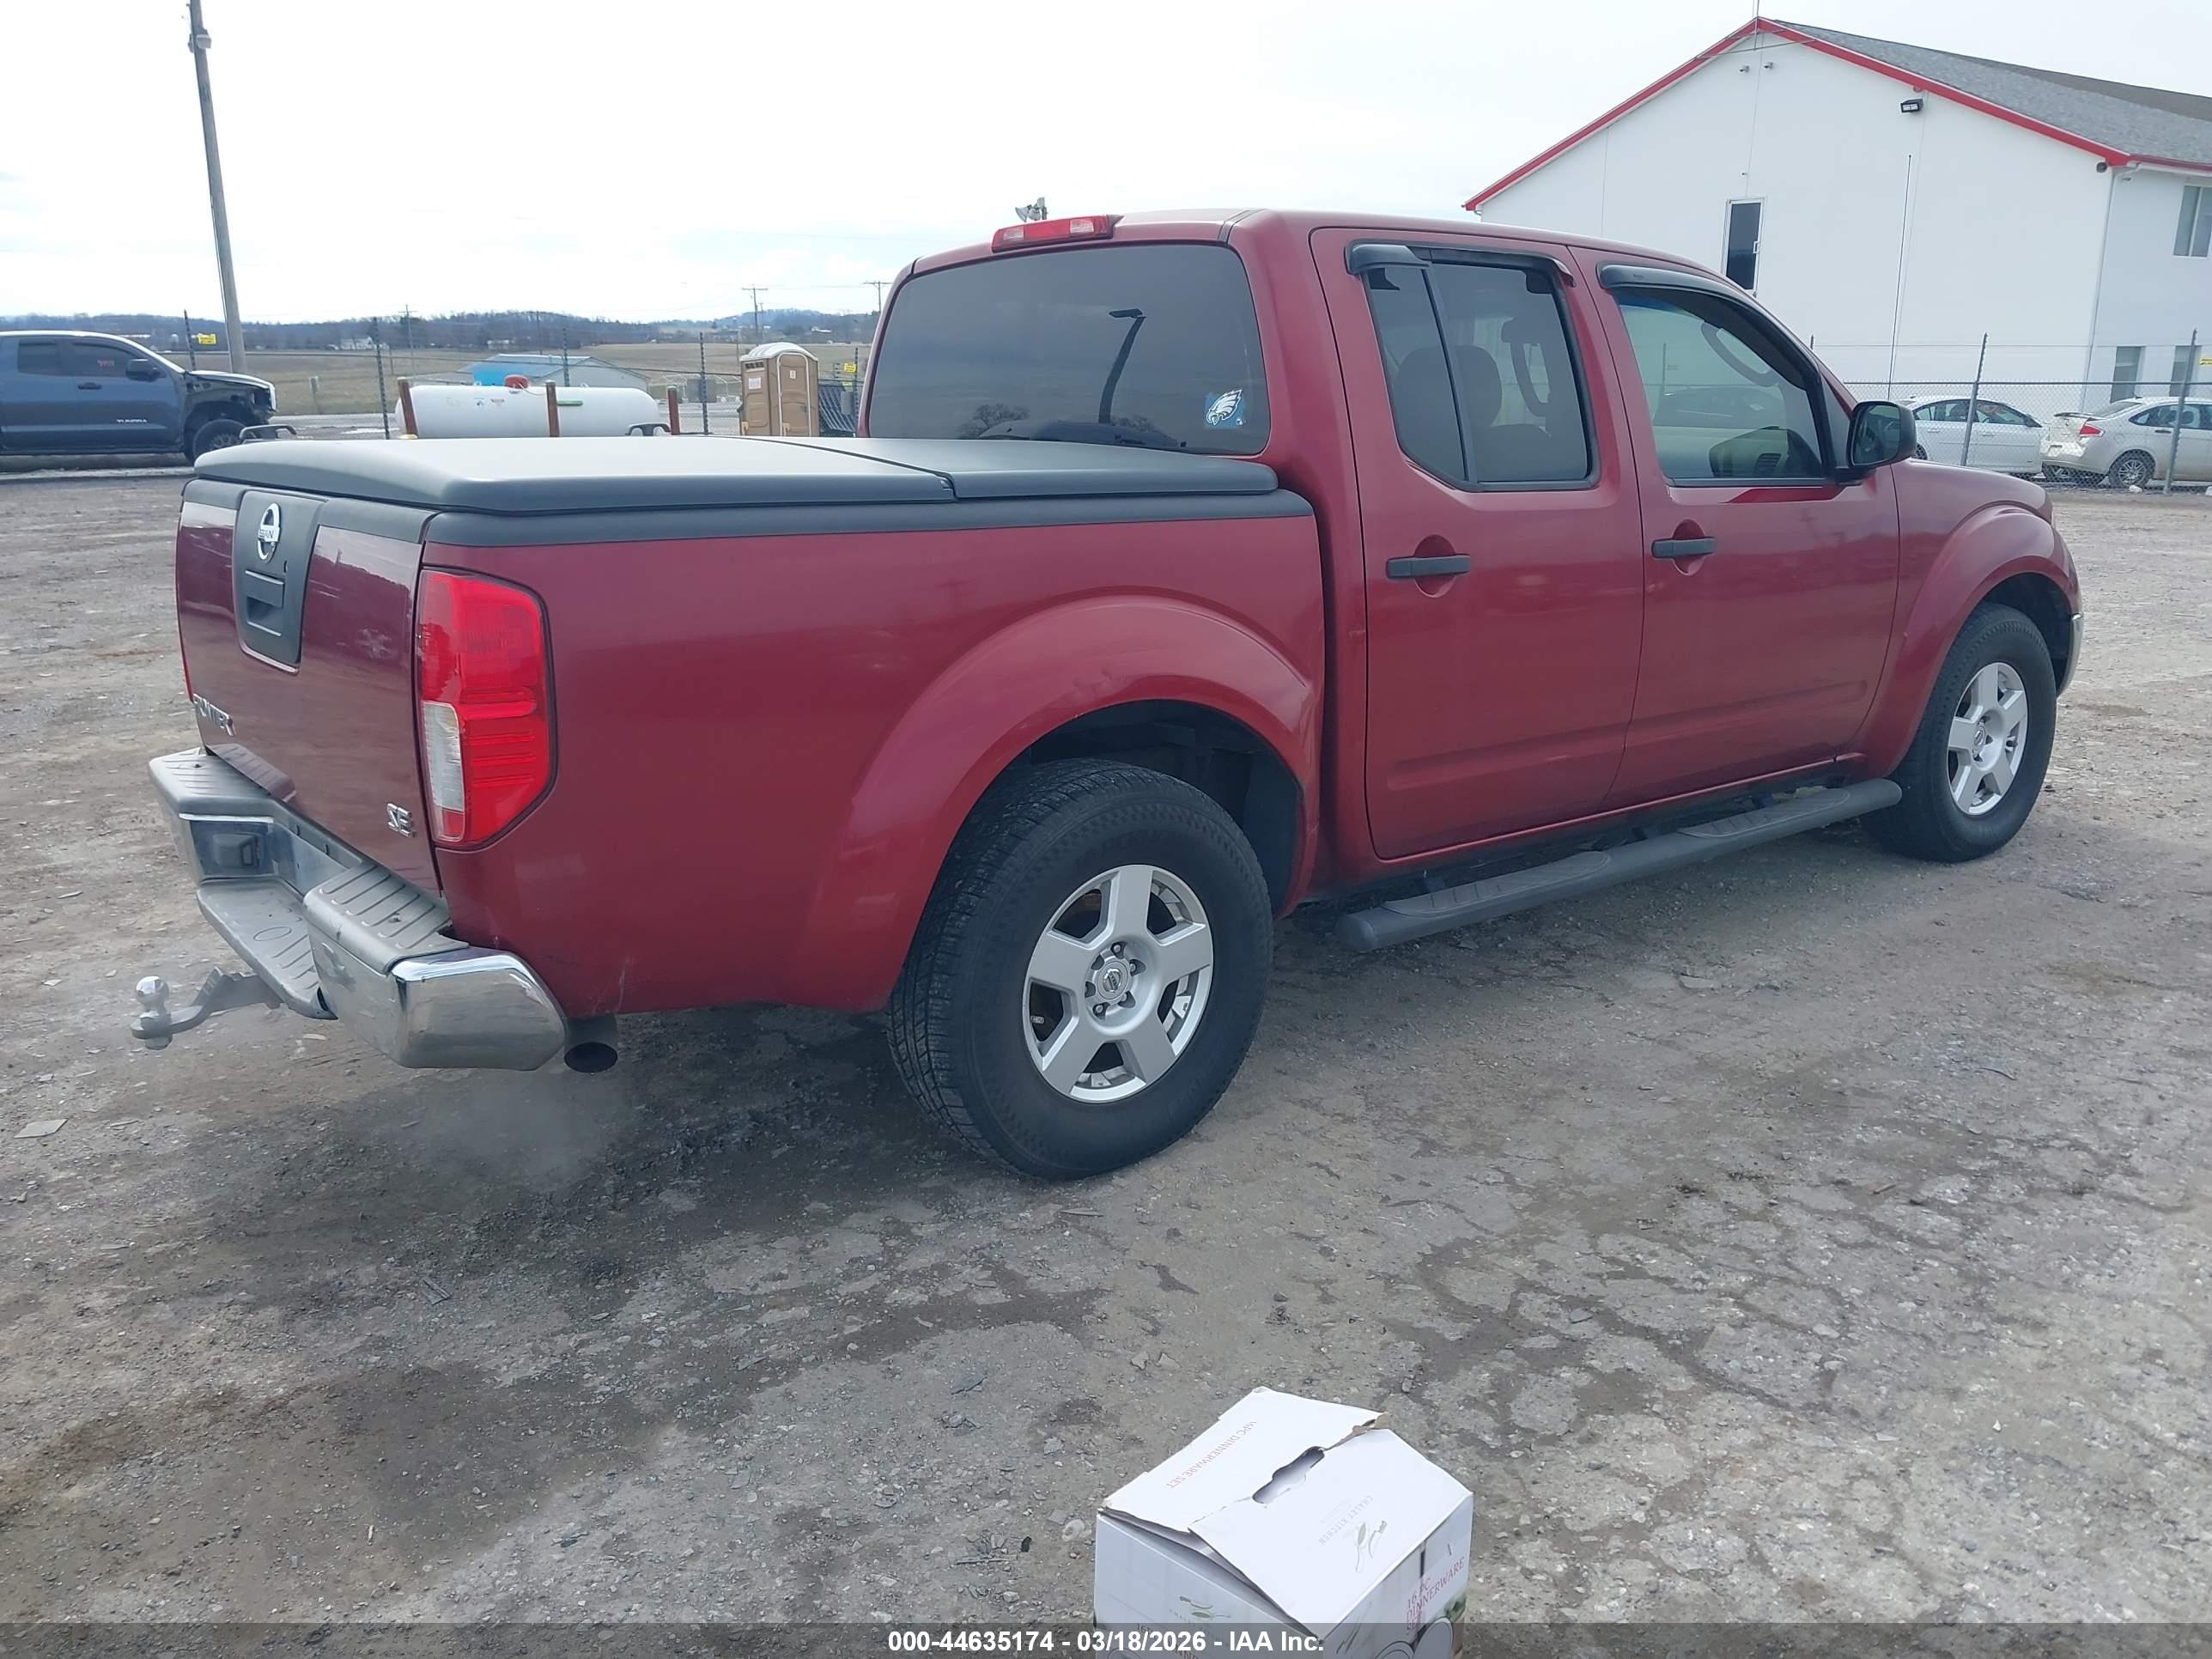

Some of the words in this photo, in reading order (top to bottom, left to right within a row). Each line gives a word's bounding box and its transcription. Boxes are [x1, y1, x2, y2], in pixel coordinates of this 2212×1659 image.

[386, 803, 411, 837] SE
[1182, 1435, 1241, 1478] DINNERWARE
[1166, 1475, 1187, 1489] SET
[1407, 1556, 1465, 1621] DINNERWARE
